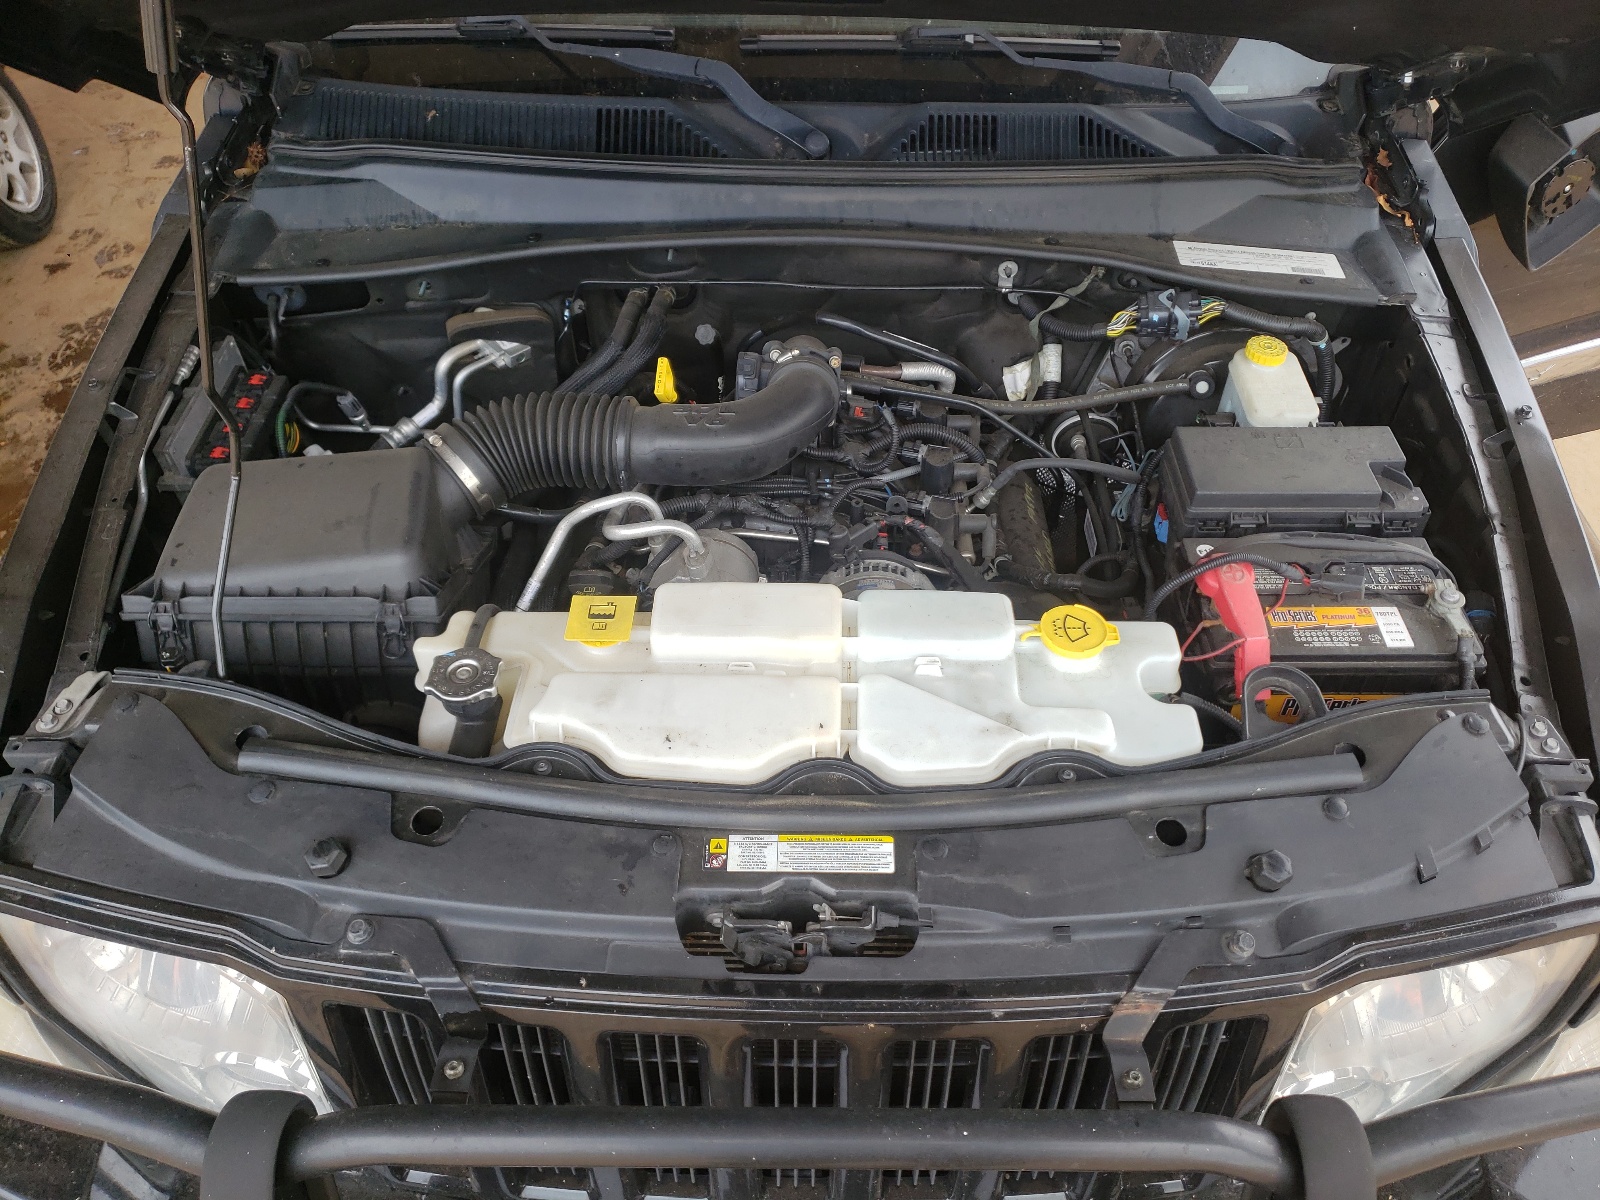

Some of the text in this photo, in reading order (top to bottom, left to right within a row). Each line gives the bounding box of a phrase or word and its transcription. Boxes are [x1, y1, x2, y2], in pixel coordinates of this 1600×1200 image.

[1271, 609, 1288, 622] Pro
[1288, 609, 1318, 622] Series
[1356, 607, 1371, 615] 36
